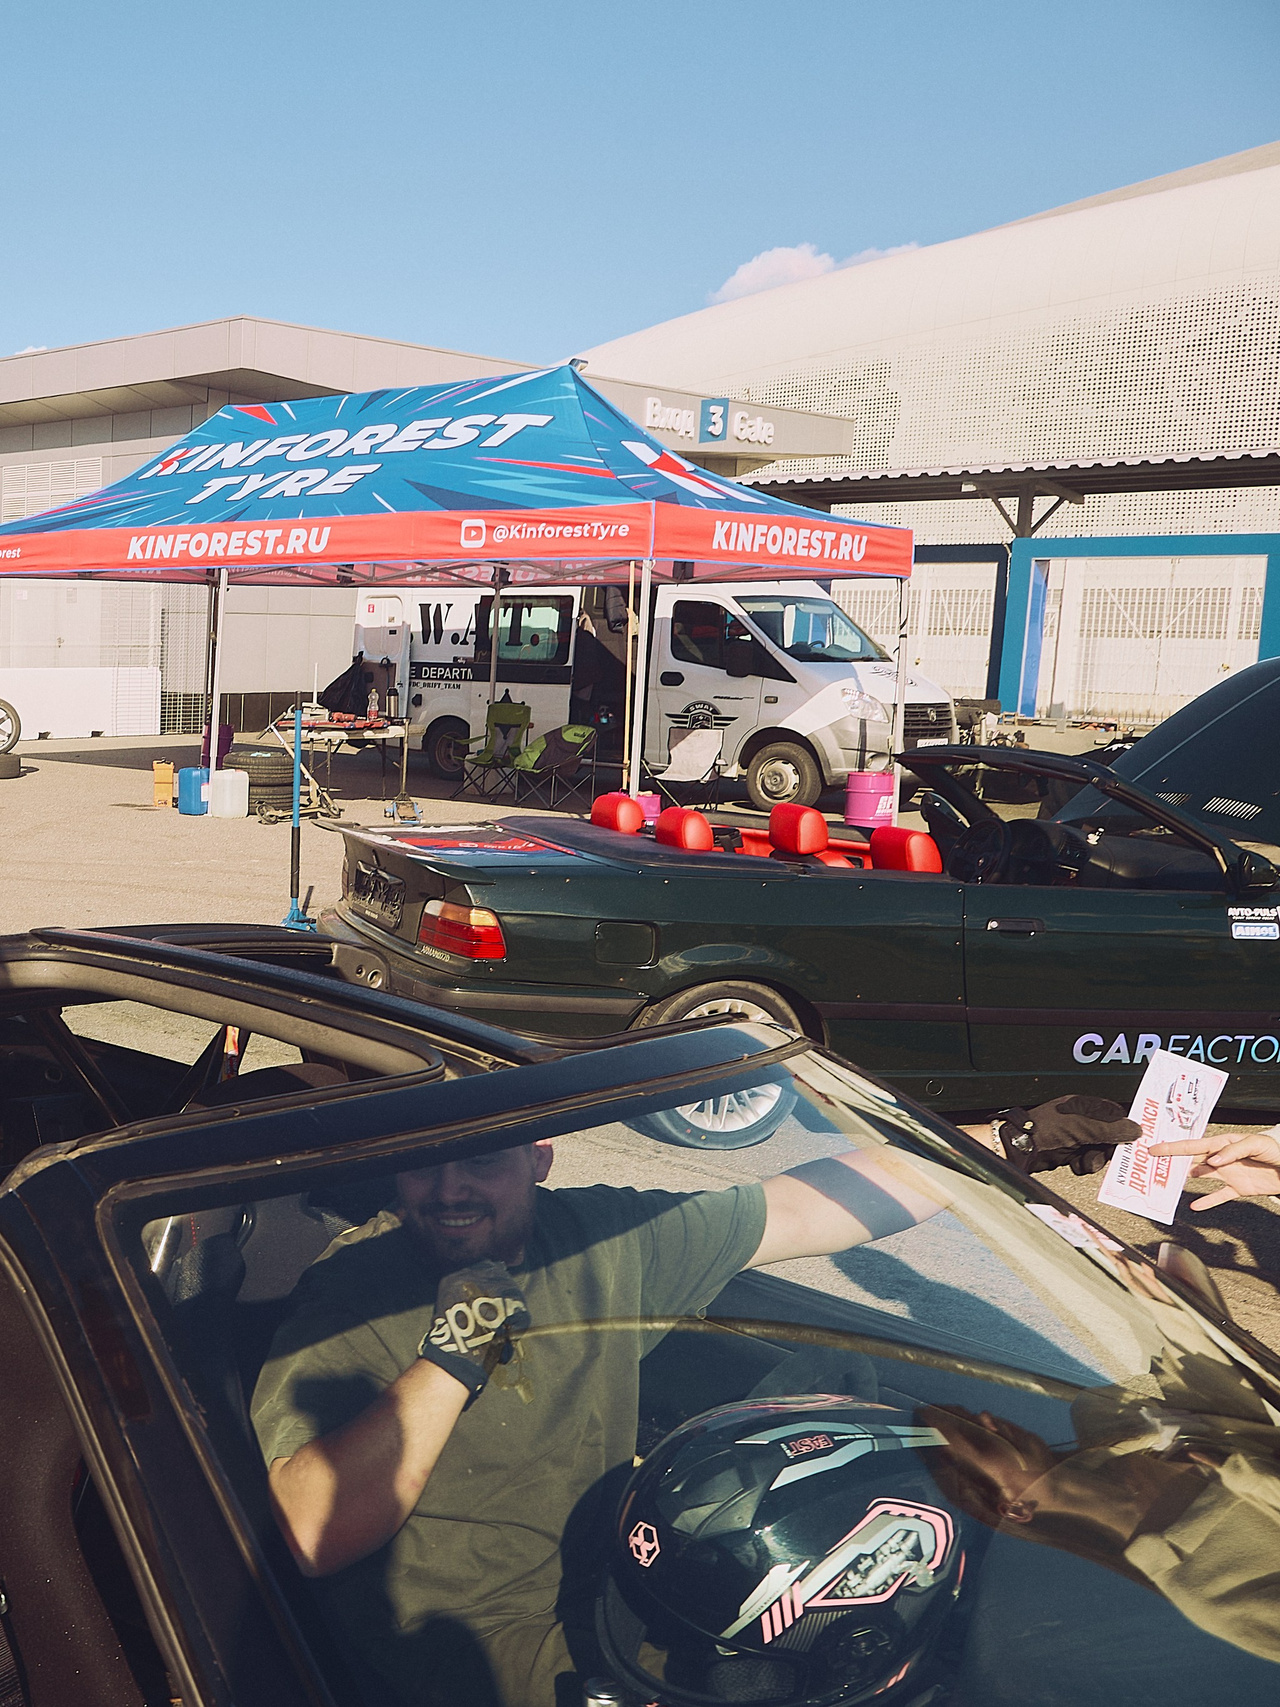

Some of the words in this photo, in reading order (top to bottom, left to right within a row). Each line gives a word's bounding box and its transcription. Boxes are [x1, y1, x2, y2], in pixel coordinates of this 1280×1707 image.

[646, 397, 695, 438] Вход
[707, 405, 724, 436] 3
[733, 411, 775, 444] Gate
[139, 414, 554, 479] KINFOREST
[186, 463, 383, 505] TYRE
[127, 527, 331, 560] KINFOREST.RU
[492, 522, 630, 543] @KinforestTyre
[712, 520, 868, 562] KINFOREST.RU
